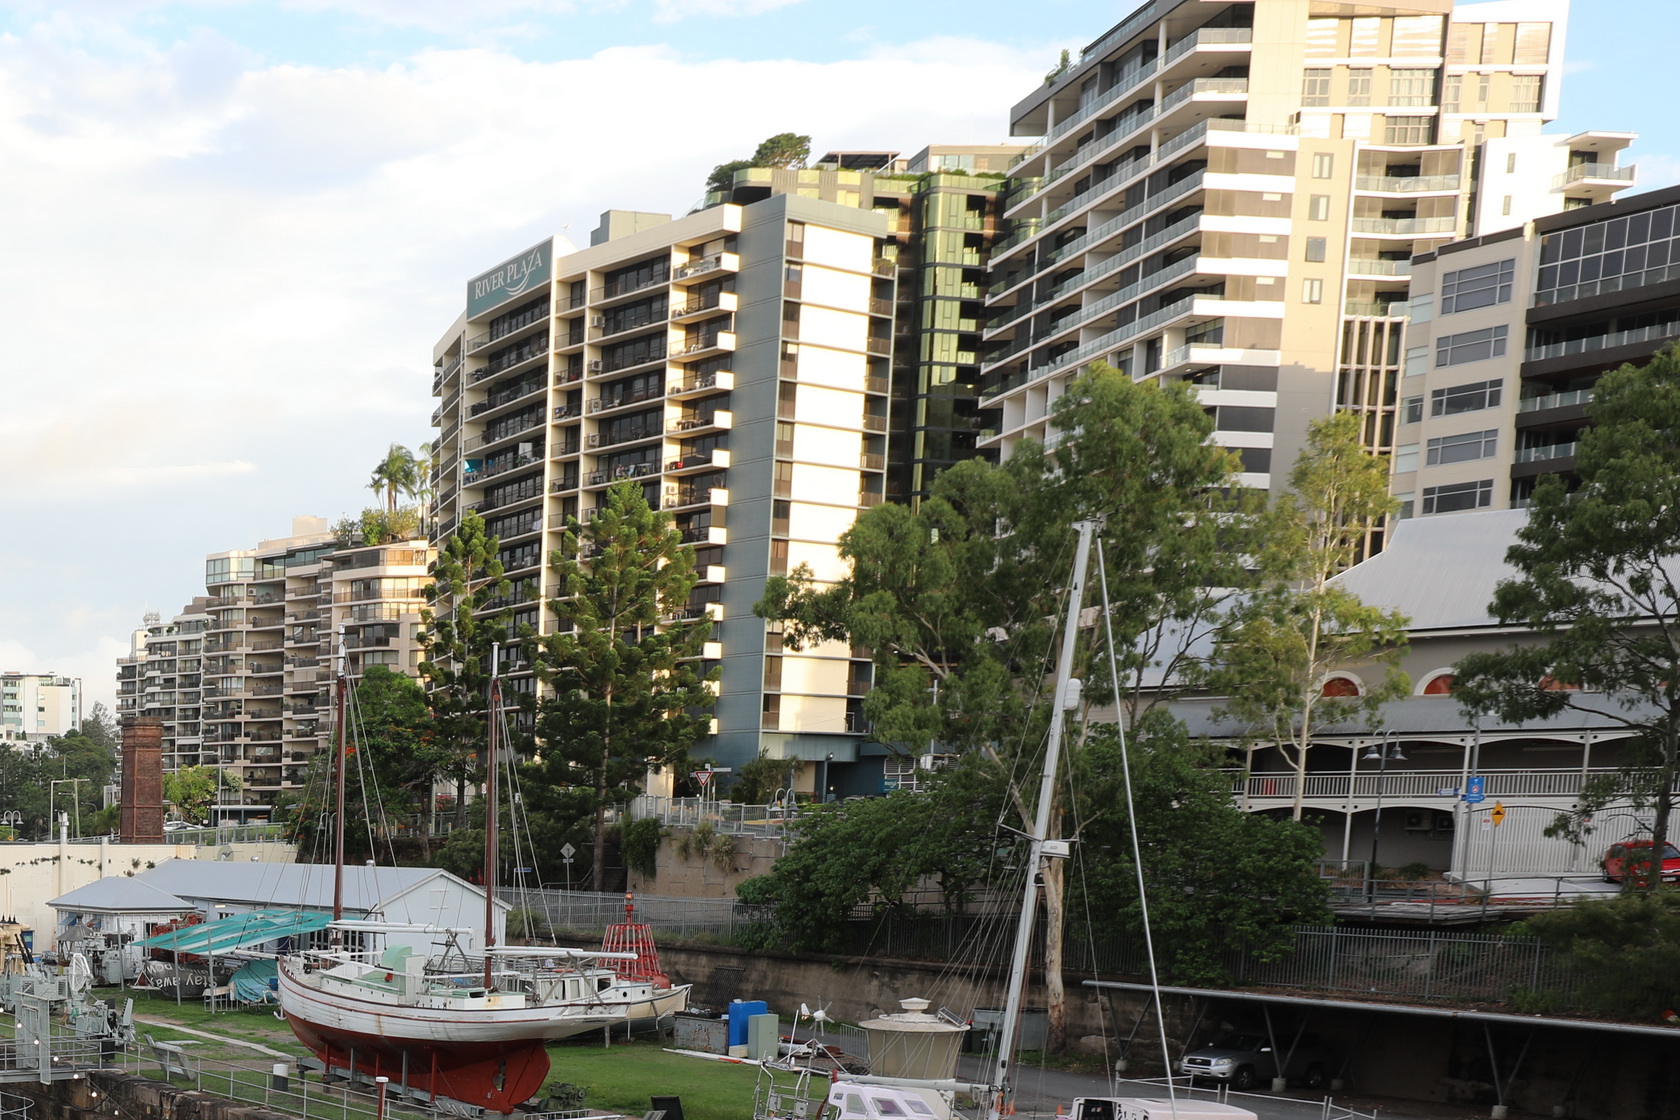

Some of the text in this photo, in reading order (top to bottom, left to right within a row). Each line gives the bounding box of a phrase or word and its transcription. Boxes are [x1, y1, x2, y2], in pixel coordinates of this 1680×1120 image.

[475, 247, 542, 299] RIVER PLAZA
[186, 972, 218, 988] Stay
